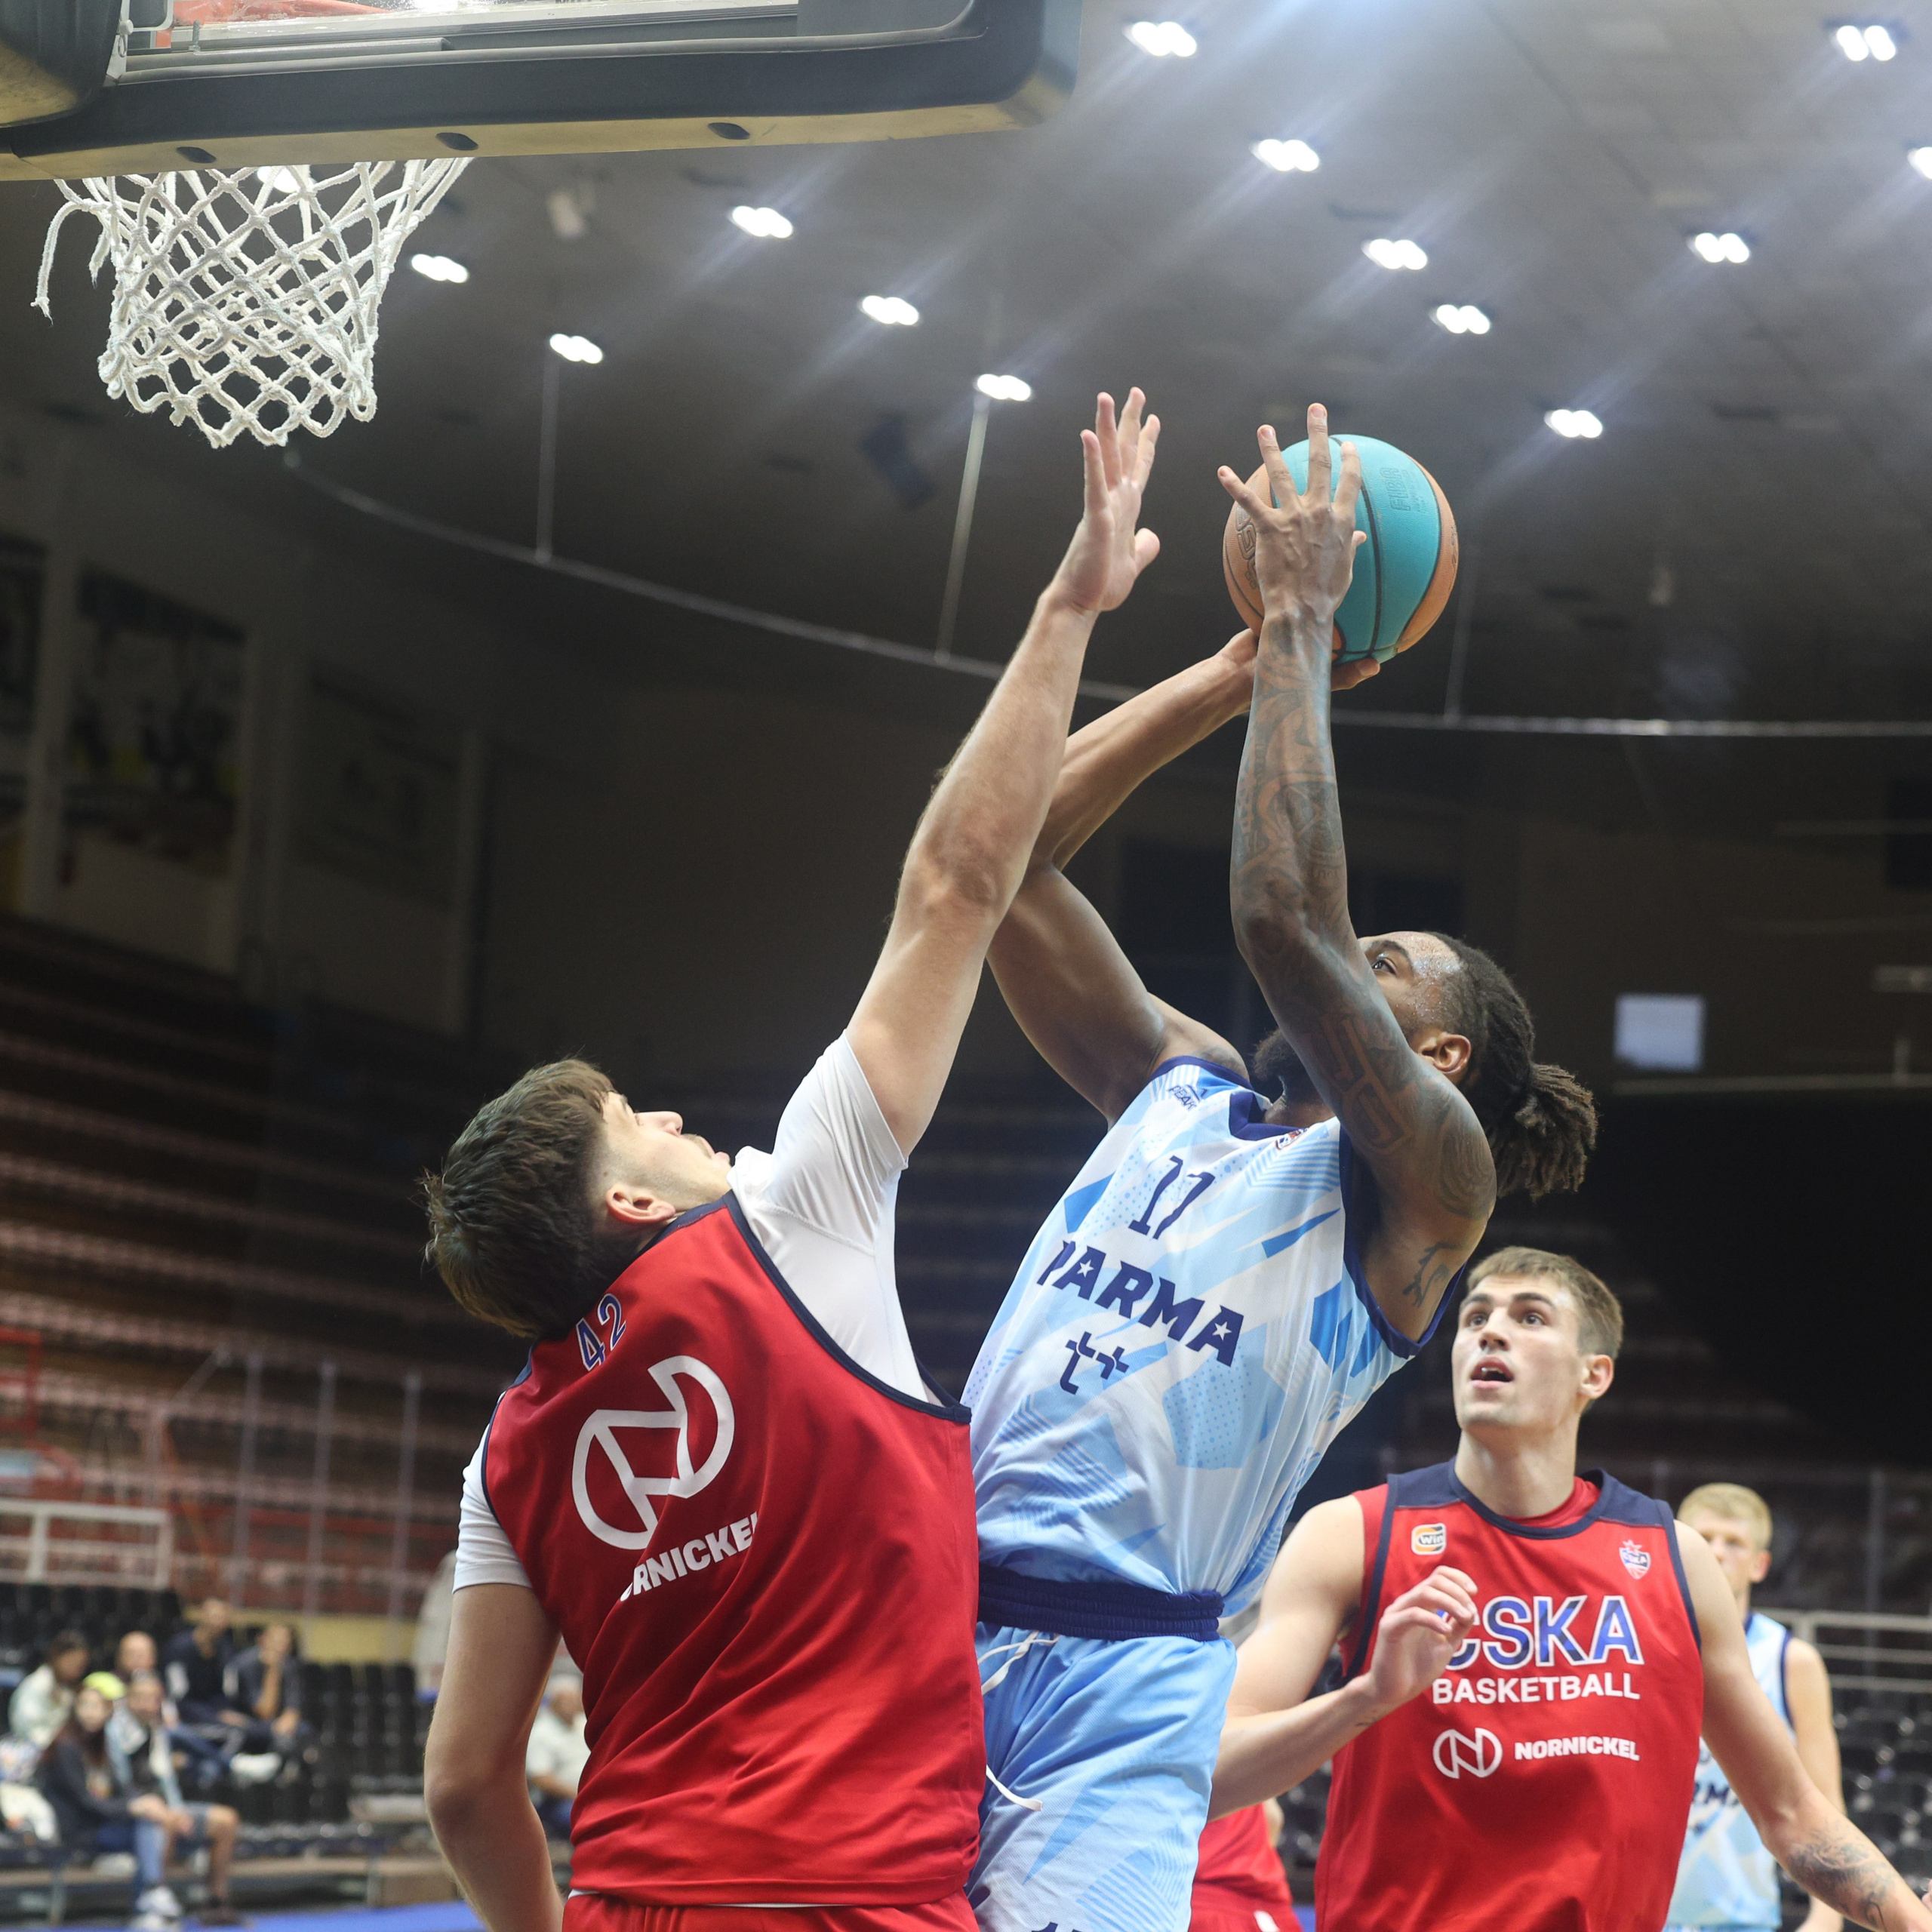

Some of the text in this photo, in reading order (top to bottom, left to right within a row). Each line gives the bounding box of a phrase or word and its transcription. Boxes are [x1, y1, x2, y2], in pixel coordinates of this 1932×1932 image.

[1167, 1085, 1197, 1111] PEAK
[576, 1294, 626, 1371] 42
[620, 1511, 758, 1601] RNICKE
[1432, 1672, 1641, 1704] BASKETBALL
[1515, 1736, 1640, 1761] NORNICKEL
